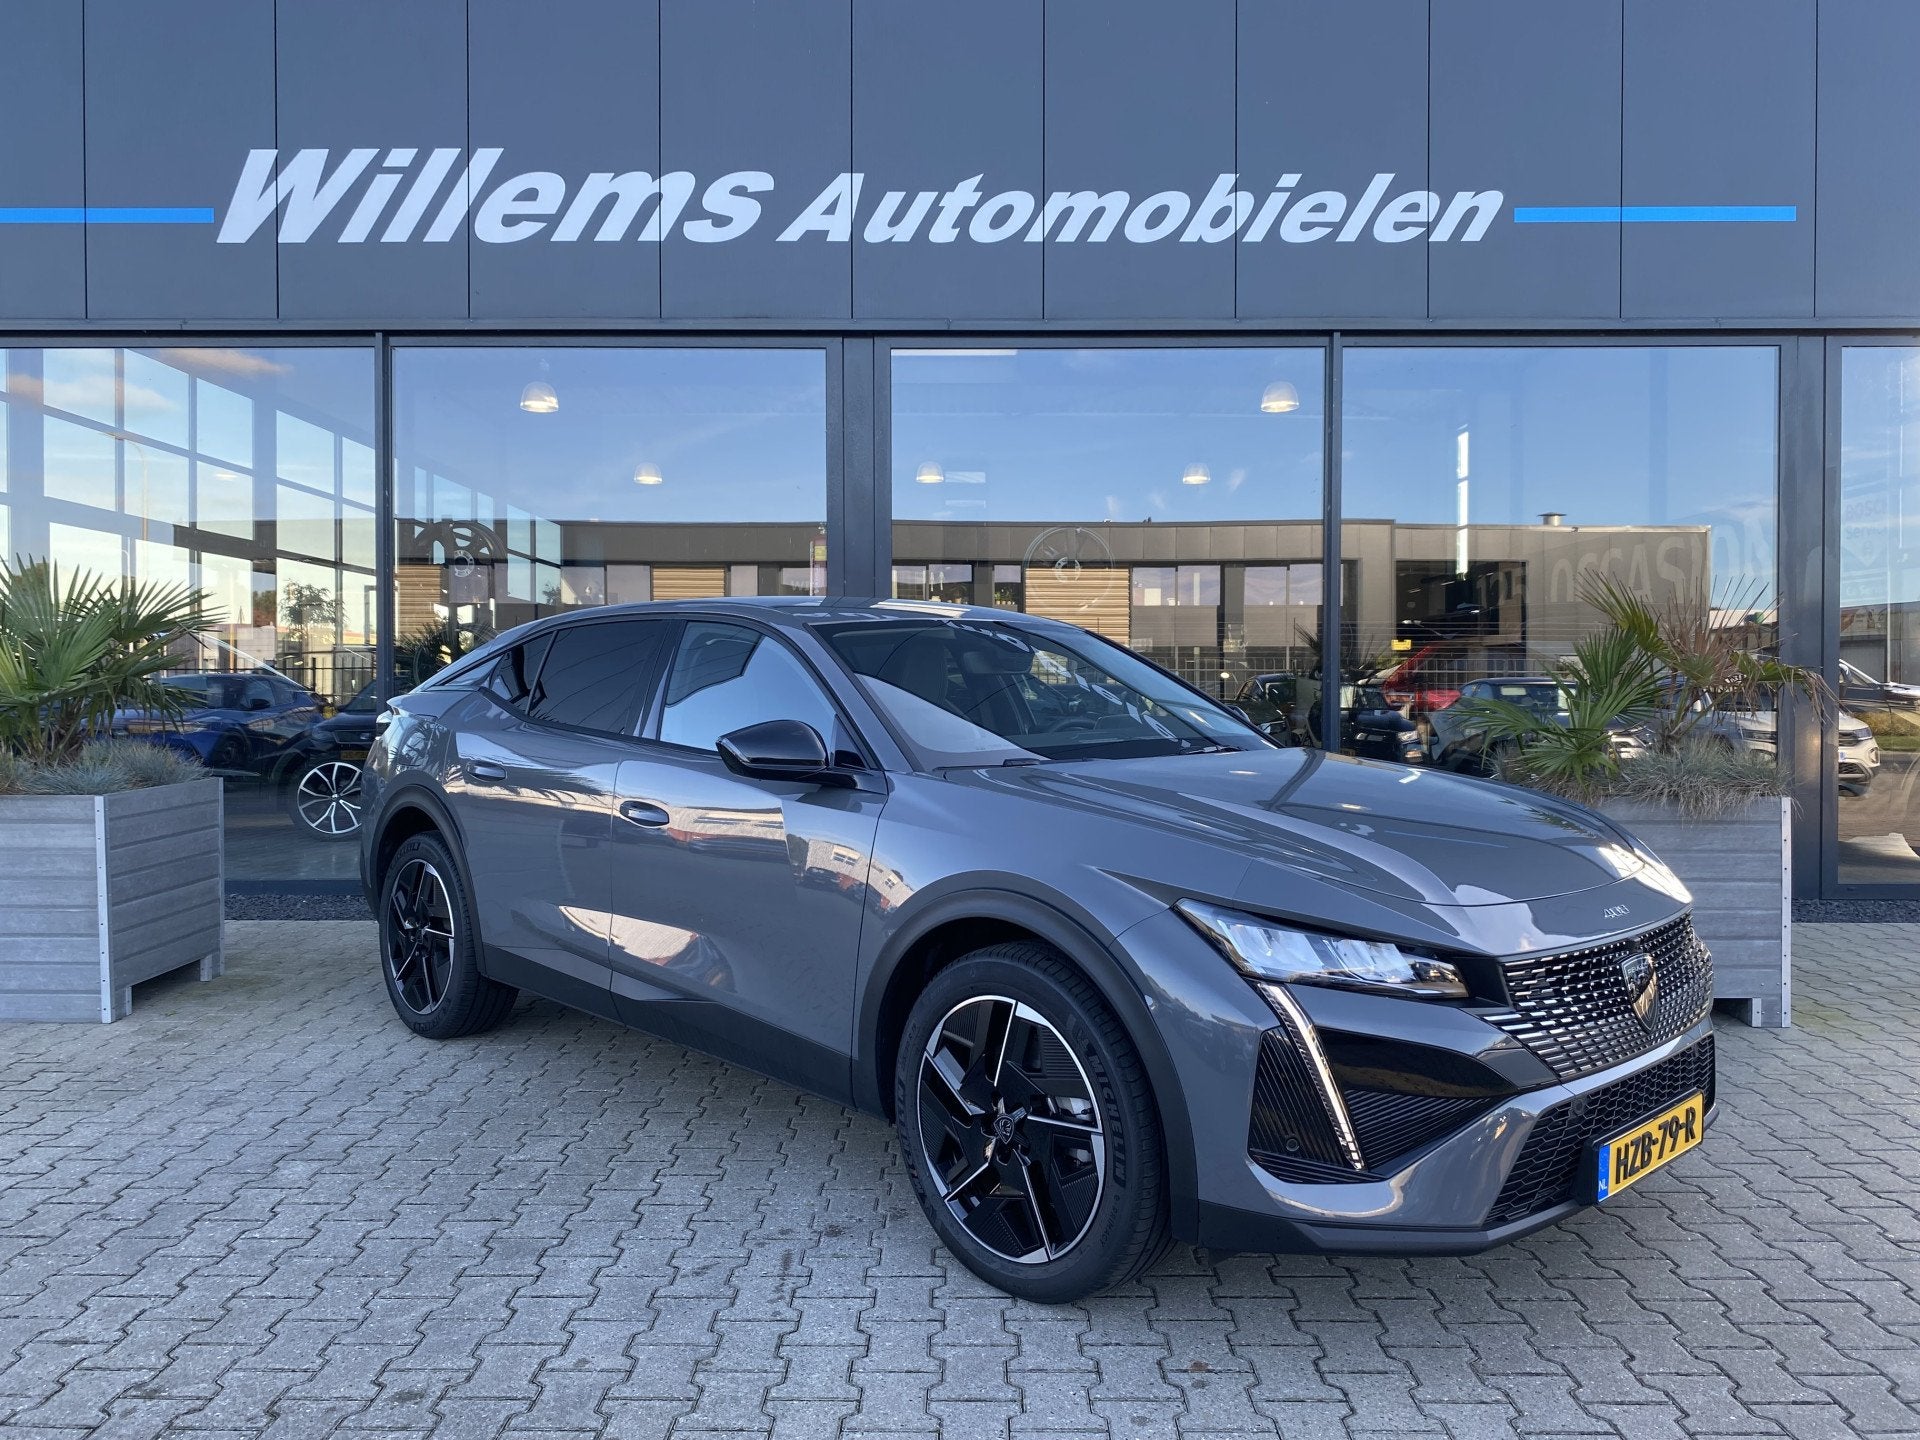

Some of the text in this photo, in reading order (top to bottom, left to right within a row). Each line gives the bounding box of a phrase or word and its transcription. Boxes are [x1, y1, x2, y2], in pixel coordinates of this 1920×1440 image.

[216, 147, 1504, 244] Willems Automobielen
[1089, 1054, 1126, 1185] MICHELIN
[1615, 1107, 1696, 1185] HZB-79-R
[1598, 1179, 1608, 1192] NL
